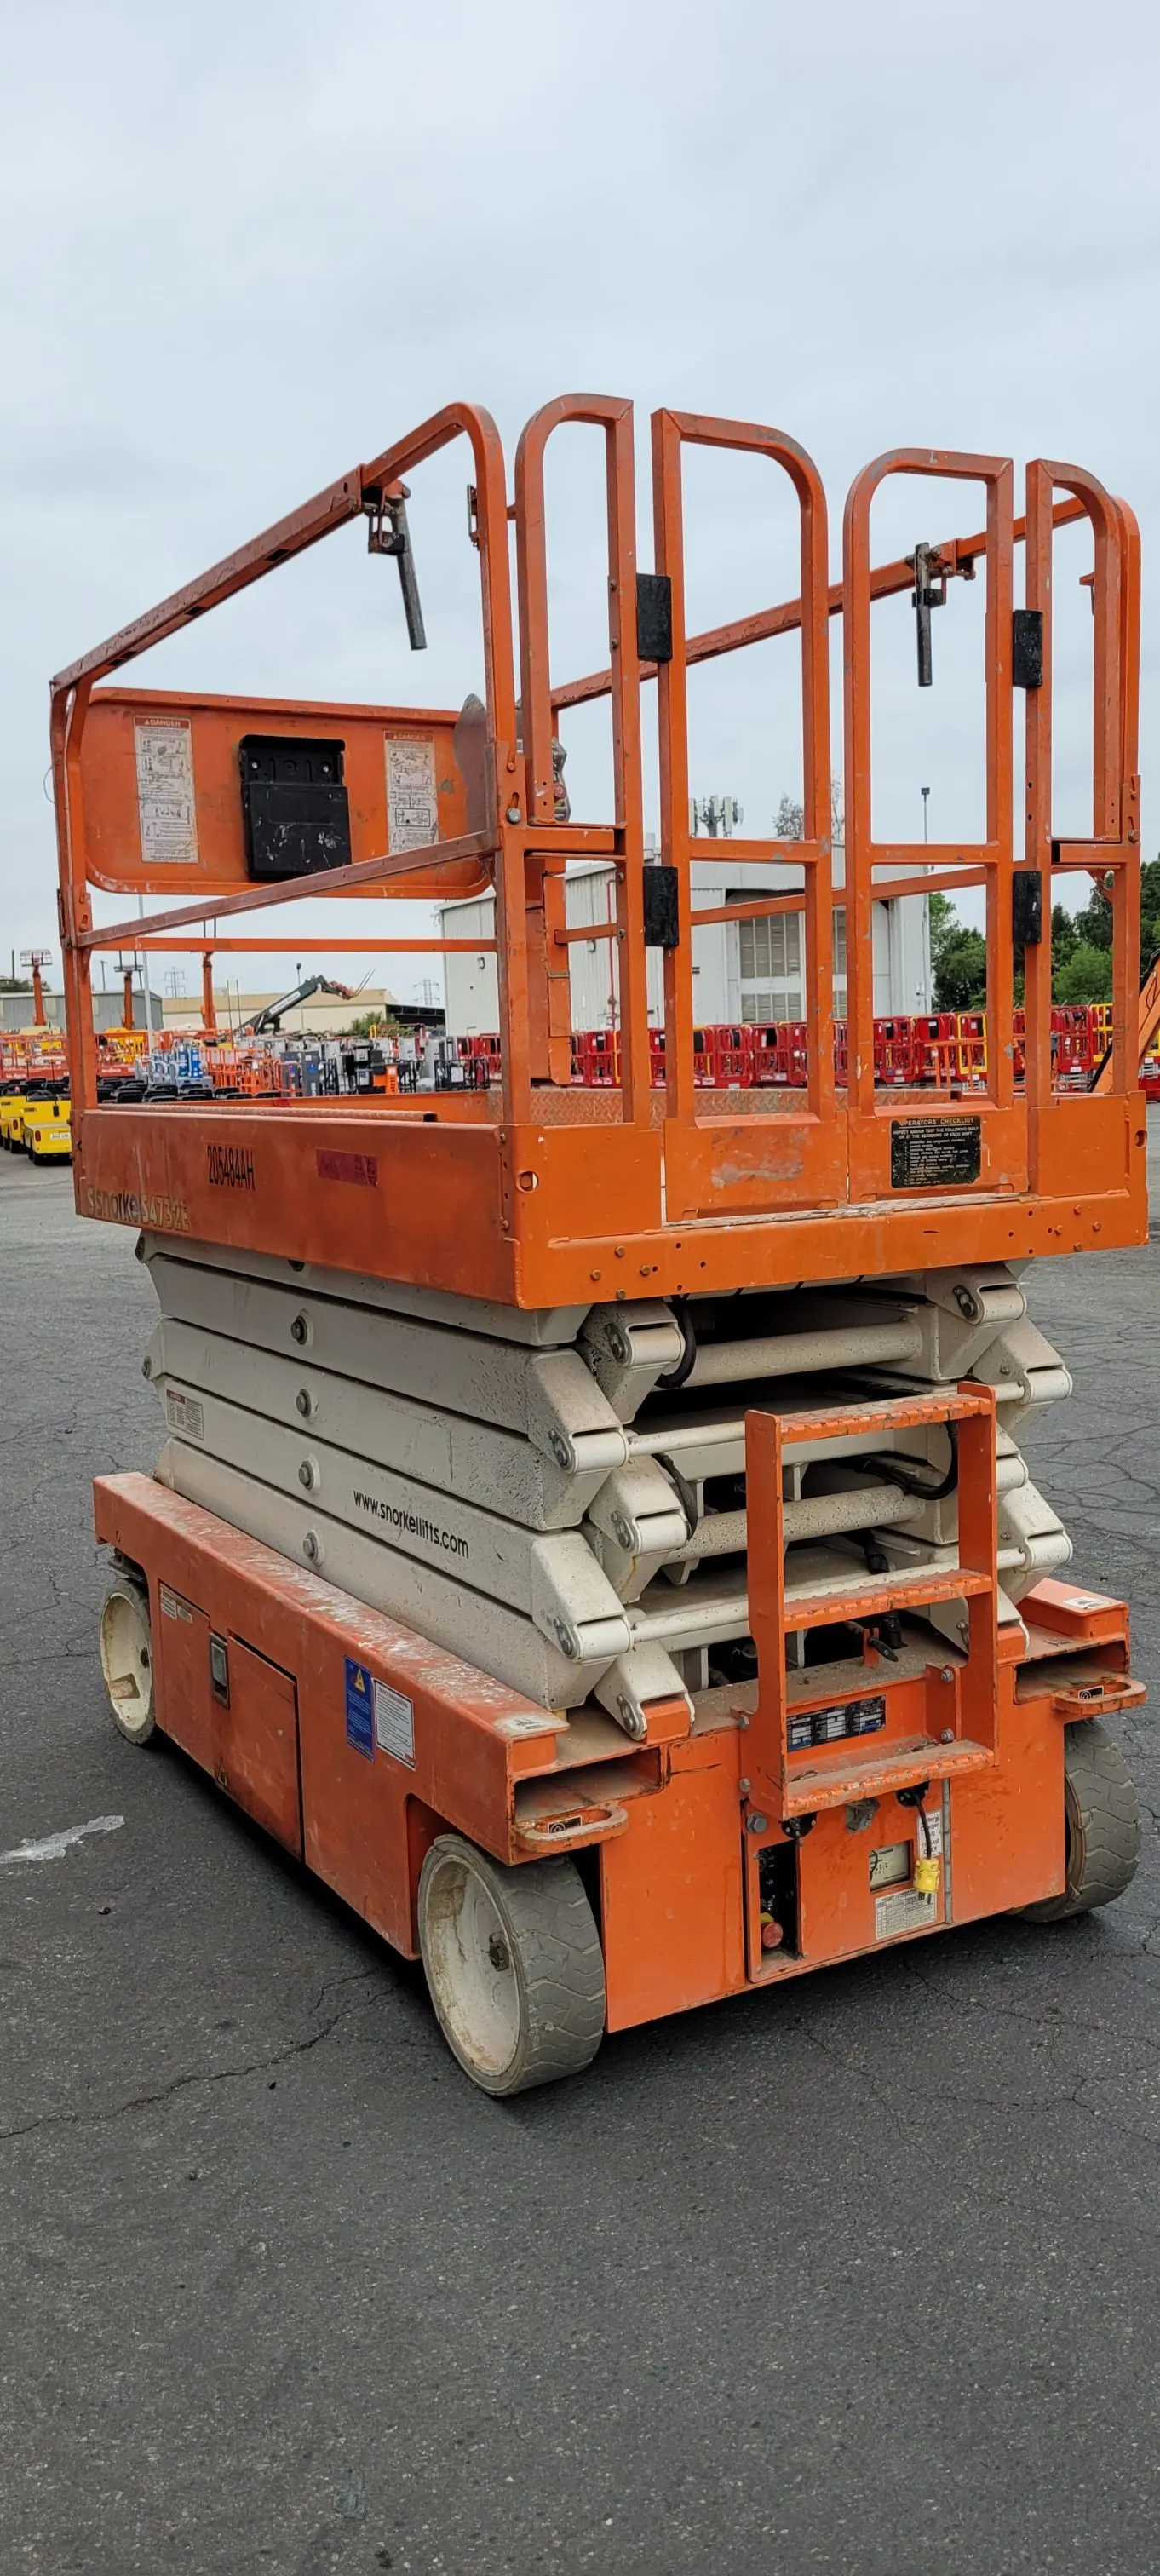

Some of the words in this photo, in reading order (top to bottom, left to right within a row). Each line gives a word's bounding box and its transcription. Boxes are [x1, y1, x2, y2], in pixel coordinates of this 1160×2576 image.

[150, 719, 181, 727] DANGER
[940, 1117, 973, 1125] CHECKLIST
[207, 1144, 255, 1191] 205484AH
[353, 1489, 469, 1559] www.snorkellifts.com
